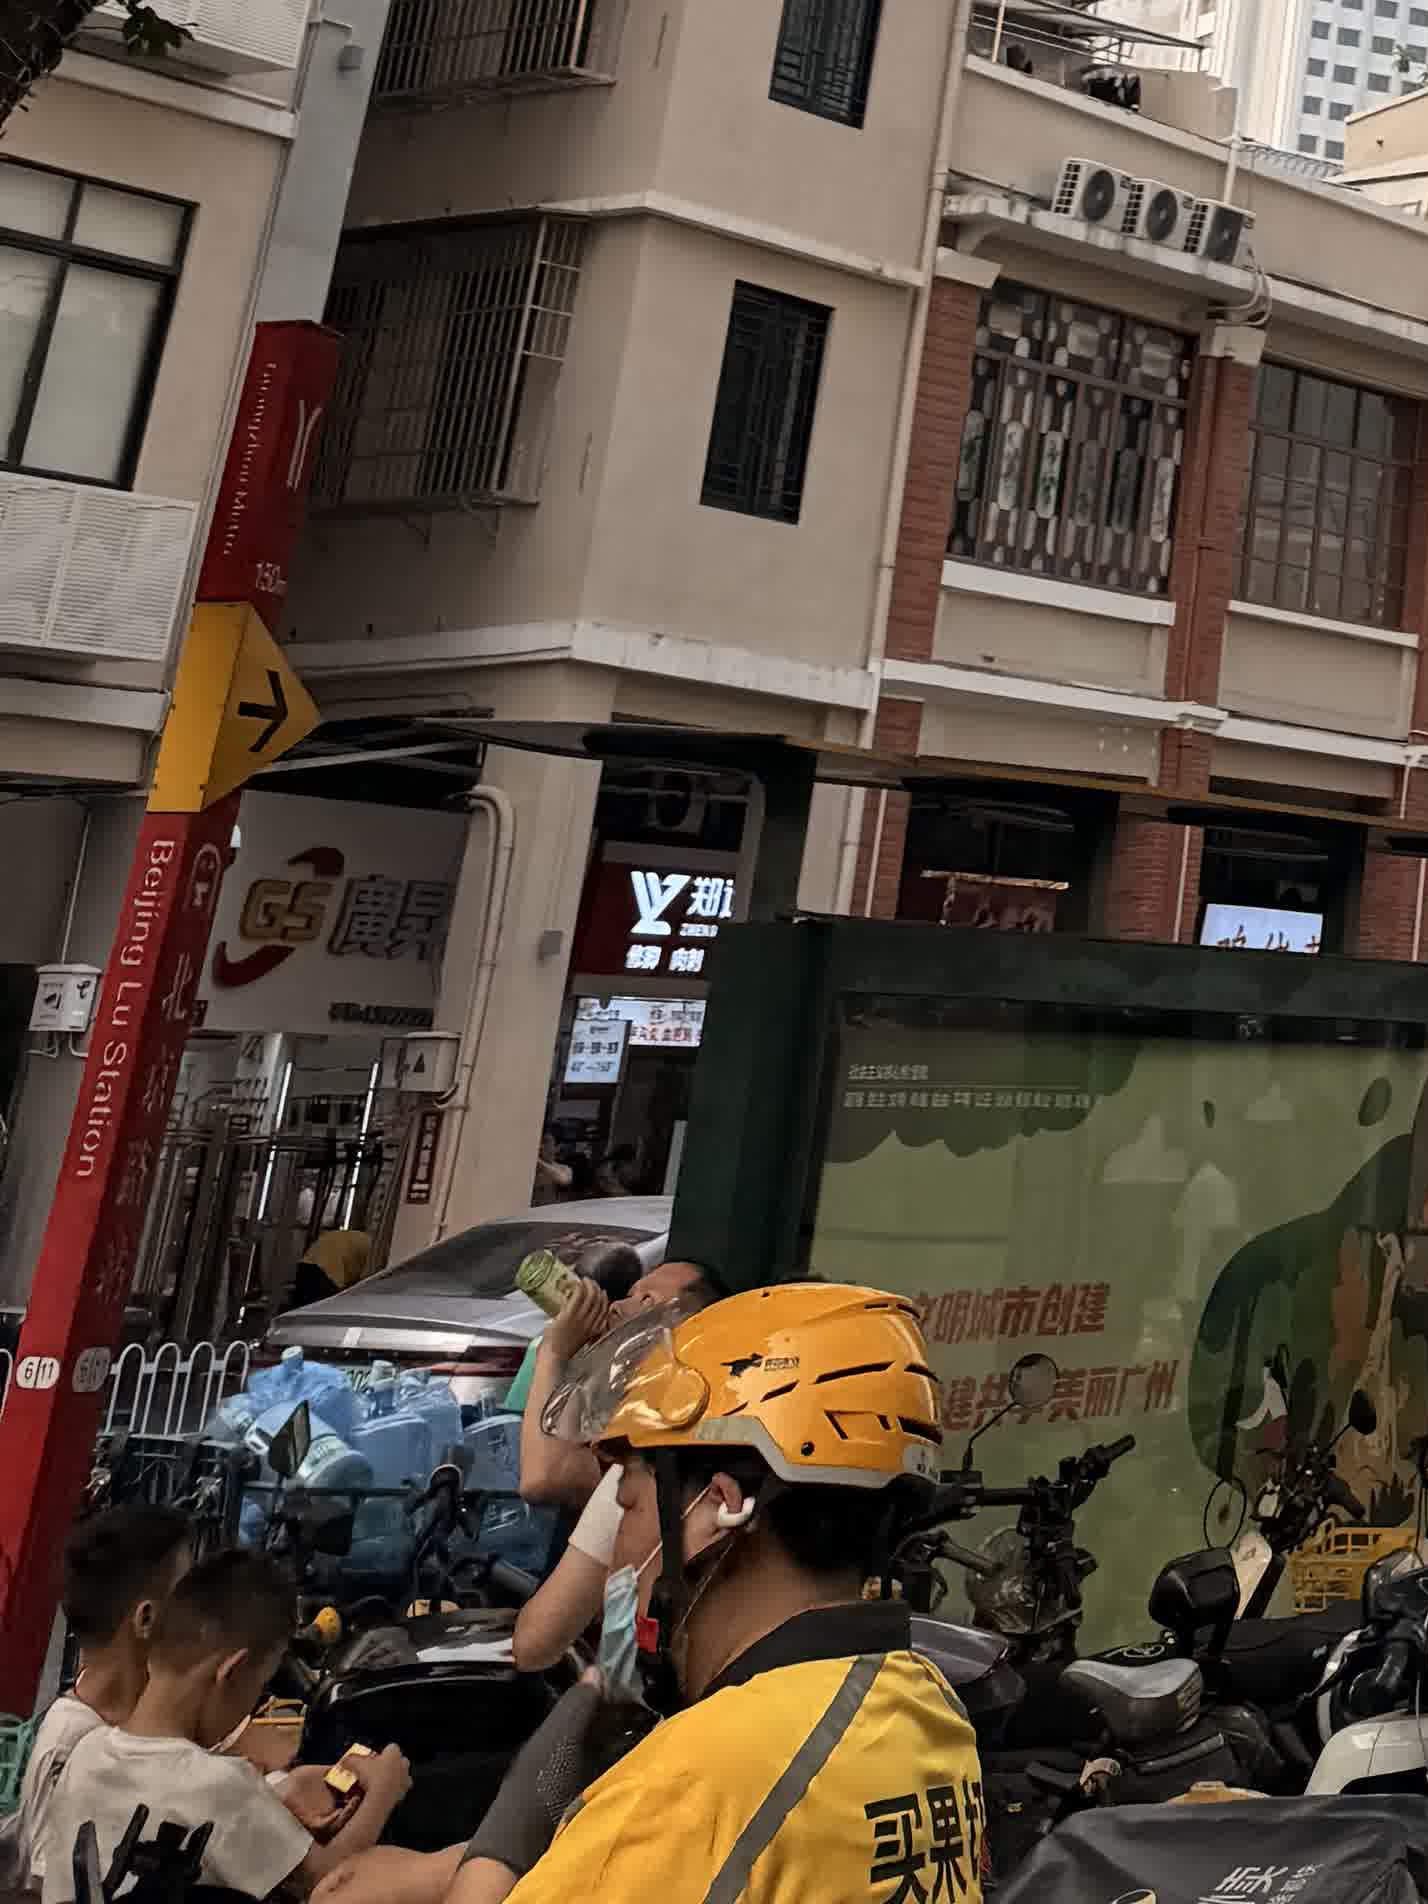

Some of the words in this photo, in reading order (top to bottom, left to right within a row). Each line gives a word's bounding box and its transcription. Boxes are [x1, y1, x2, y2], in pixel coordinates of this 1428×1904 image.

[118, 838, 176, 965] Beijing
[241, 877, 332, 943] GS
[111, 980, 145, 1027] Lu
[74, 1040, 128, 1178] Station
[24, 1360, 34, 1380] 6
[40, 1360, 55, 1380] 11
